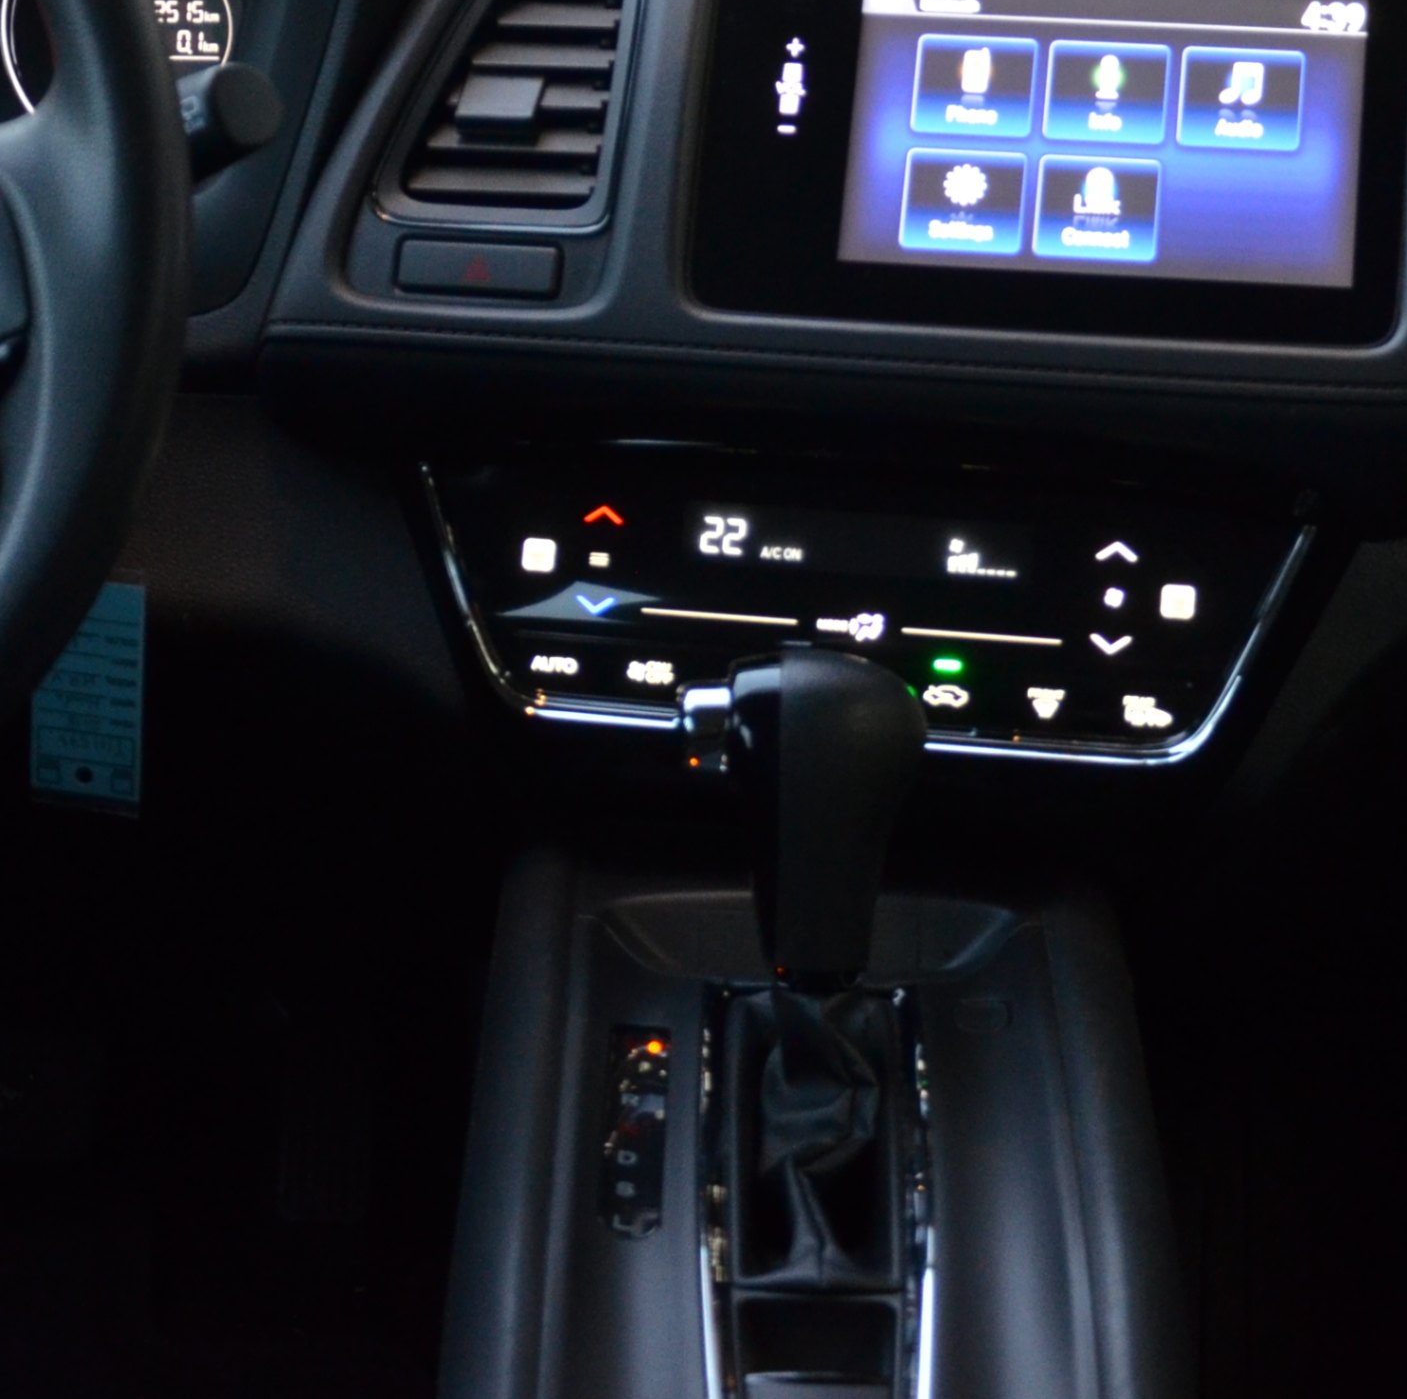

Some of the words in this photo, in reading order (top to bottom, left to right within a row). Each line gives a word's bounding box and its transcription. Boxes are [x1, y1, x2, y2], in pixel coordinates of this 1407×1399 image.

[1301, 0, 1366, 32] 4:39
[699, 516, 748, 555] 22
[760, 545, 782, 559] A/C
[783, 547, 803, 561] ON
[530, 655, 579, 675] AUTO
